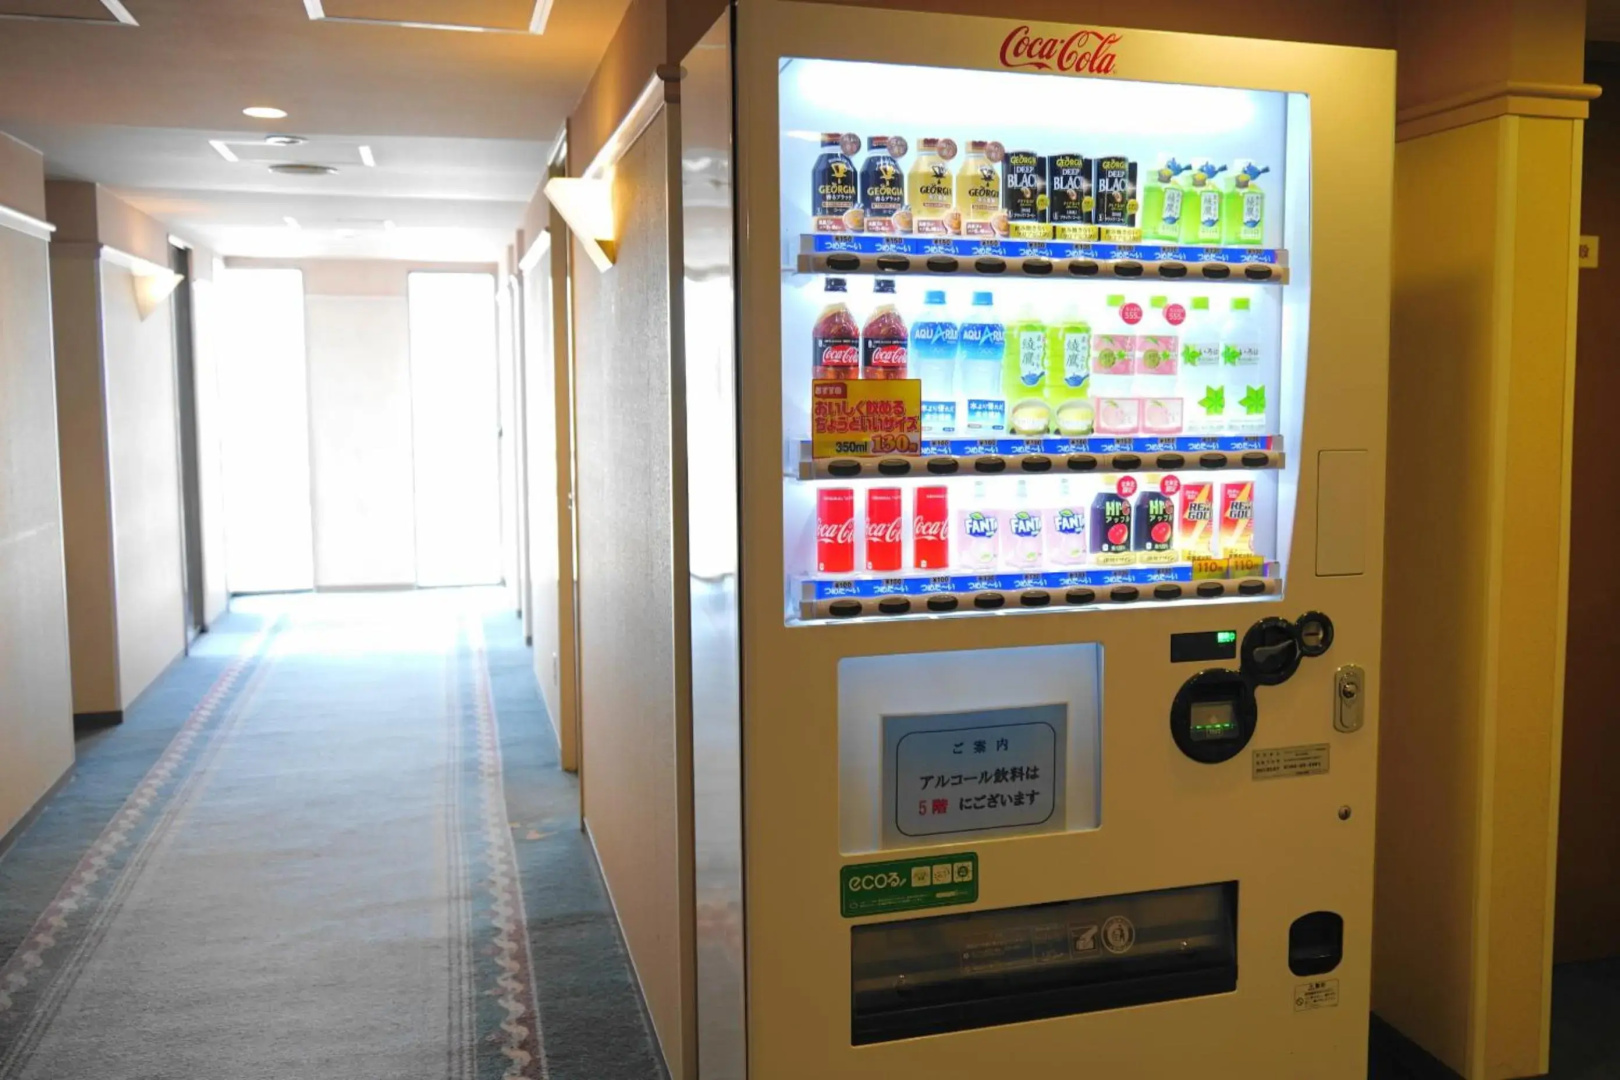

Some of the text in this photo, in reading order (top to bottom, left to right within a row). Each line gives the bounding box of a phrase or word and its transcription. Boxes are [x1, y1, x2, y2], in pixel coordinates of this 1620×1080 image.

[1000, 25, 1123, 74] Coca-Cola
[1007, 173, 1038, 189] BLAC
[1054, 175, 1084, 190] BLAC
[1099, 177, 1128, 192] BLAC
[920, 185, 952, 195] GEORGI
[823, 345, 859, 364] Coca-Col
[872, 346, 908, 364] Coca-Col
[815, 400, 906, 416] おいしく飲める
[815, 416, 920, 433] ちょうどいいサイズ
[836, 441, 868, 453] 350ml
[1188, 511, 1209, 519] GOL
[1230, 510, 1250, 518] GOL
[965, 518, 998, 534] FANT
[1010, 518, 1042, 534] FANT
[1054, 514, 1085, 532] FANT
[952, 738, 1010, 755] ご案内
[919, 766, 1040, 791] アルコール飲料は
[959, 790, 1040, 812] にございます
